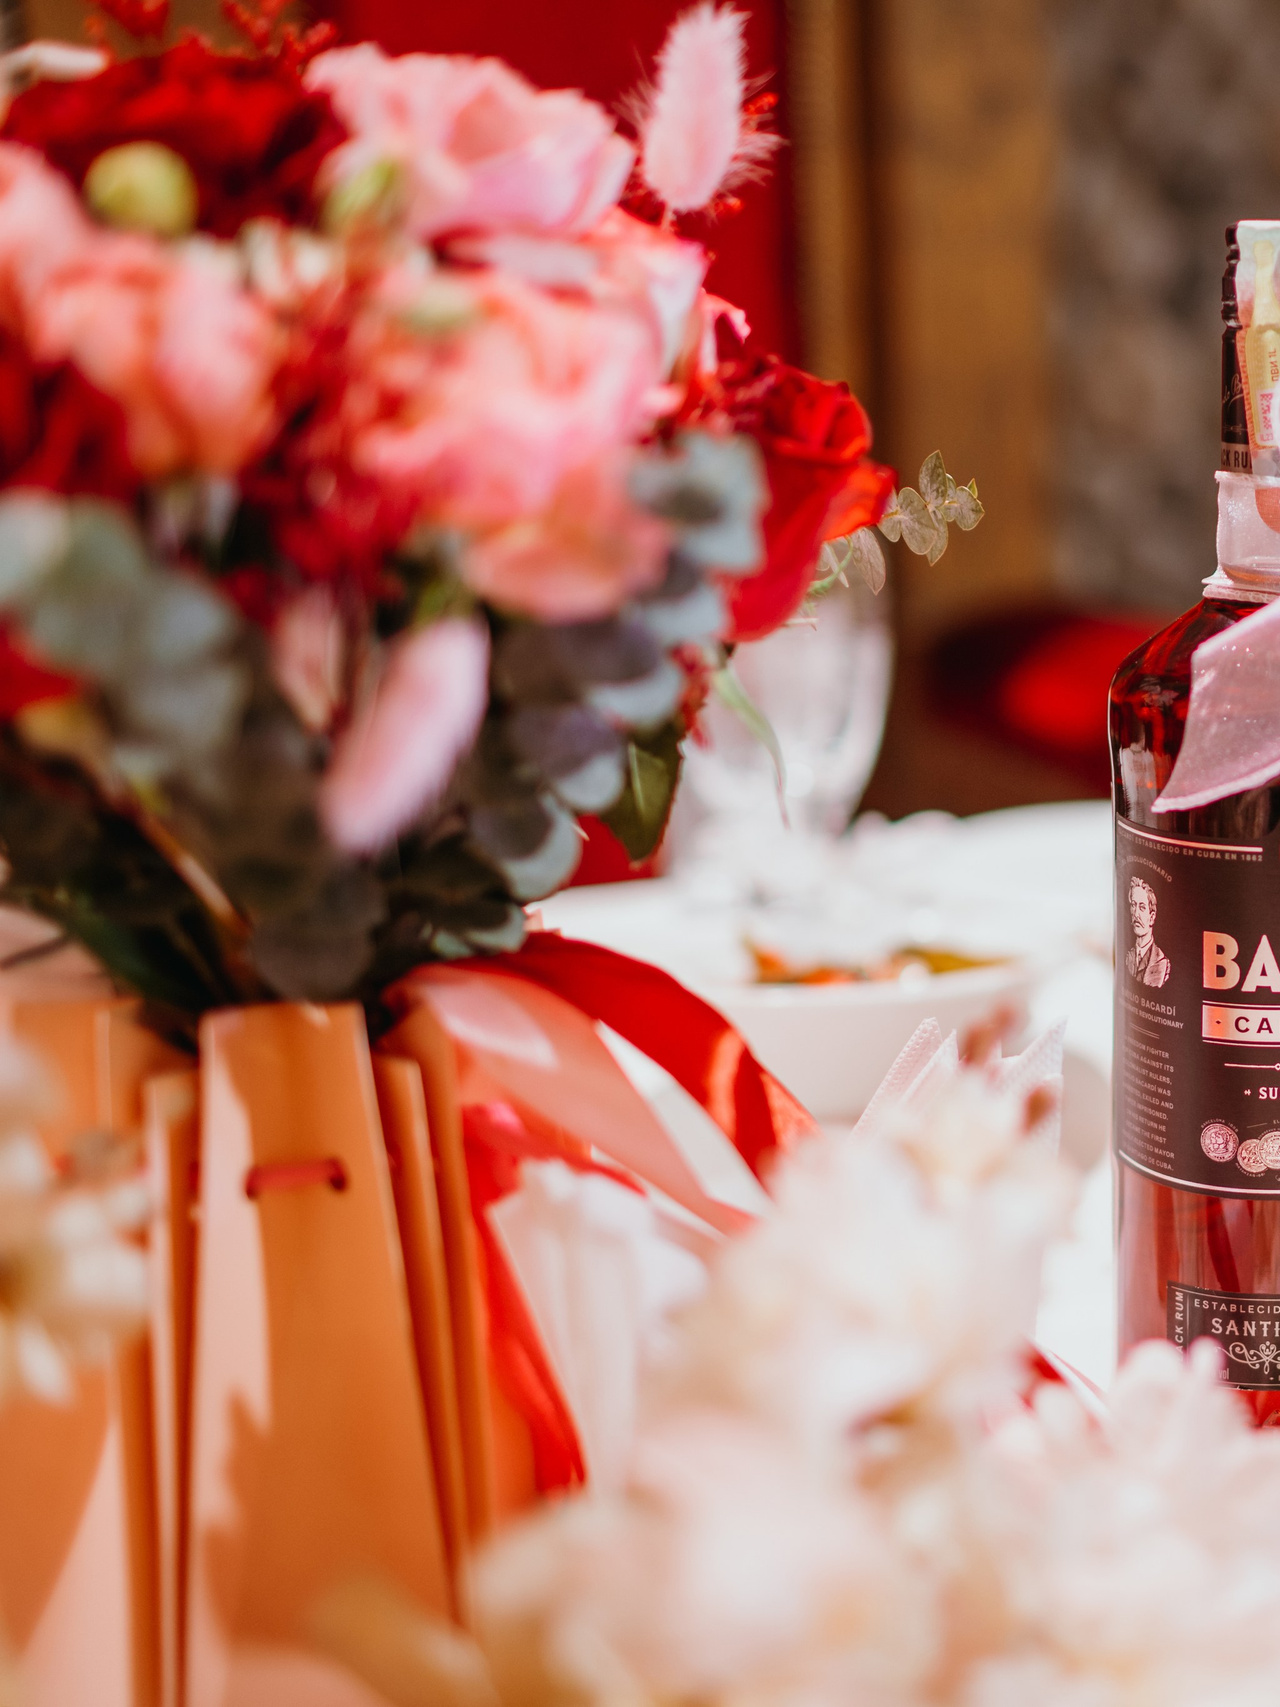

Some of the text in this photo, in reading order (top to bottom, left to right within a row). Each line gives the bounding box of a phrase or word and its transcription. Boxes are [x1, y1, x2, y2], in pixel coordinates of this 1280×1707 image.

[1234, 449, 1252, 469] RU
[1183, 848, 1194, 856] EN
[1197, 850, 1221, 859] CUBA
[1225, 852, 1237, 860] EN
[1241, 854, 1263, 862] 1862
[1139, 1010, 1184, 1029] REVOLUTIONARY
[1164, 1064, 1174, 1073] ITS
[1157, 1086, 1172, 1097] WAS
[1160, 1100, 1174, 1110] AND
[1159, 1124, 1167, 1132] HE
[1154, 1147, 1175, 1159] MAYOR
[1175, 1291, 1184, 1321] RUM
